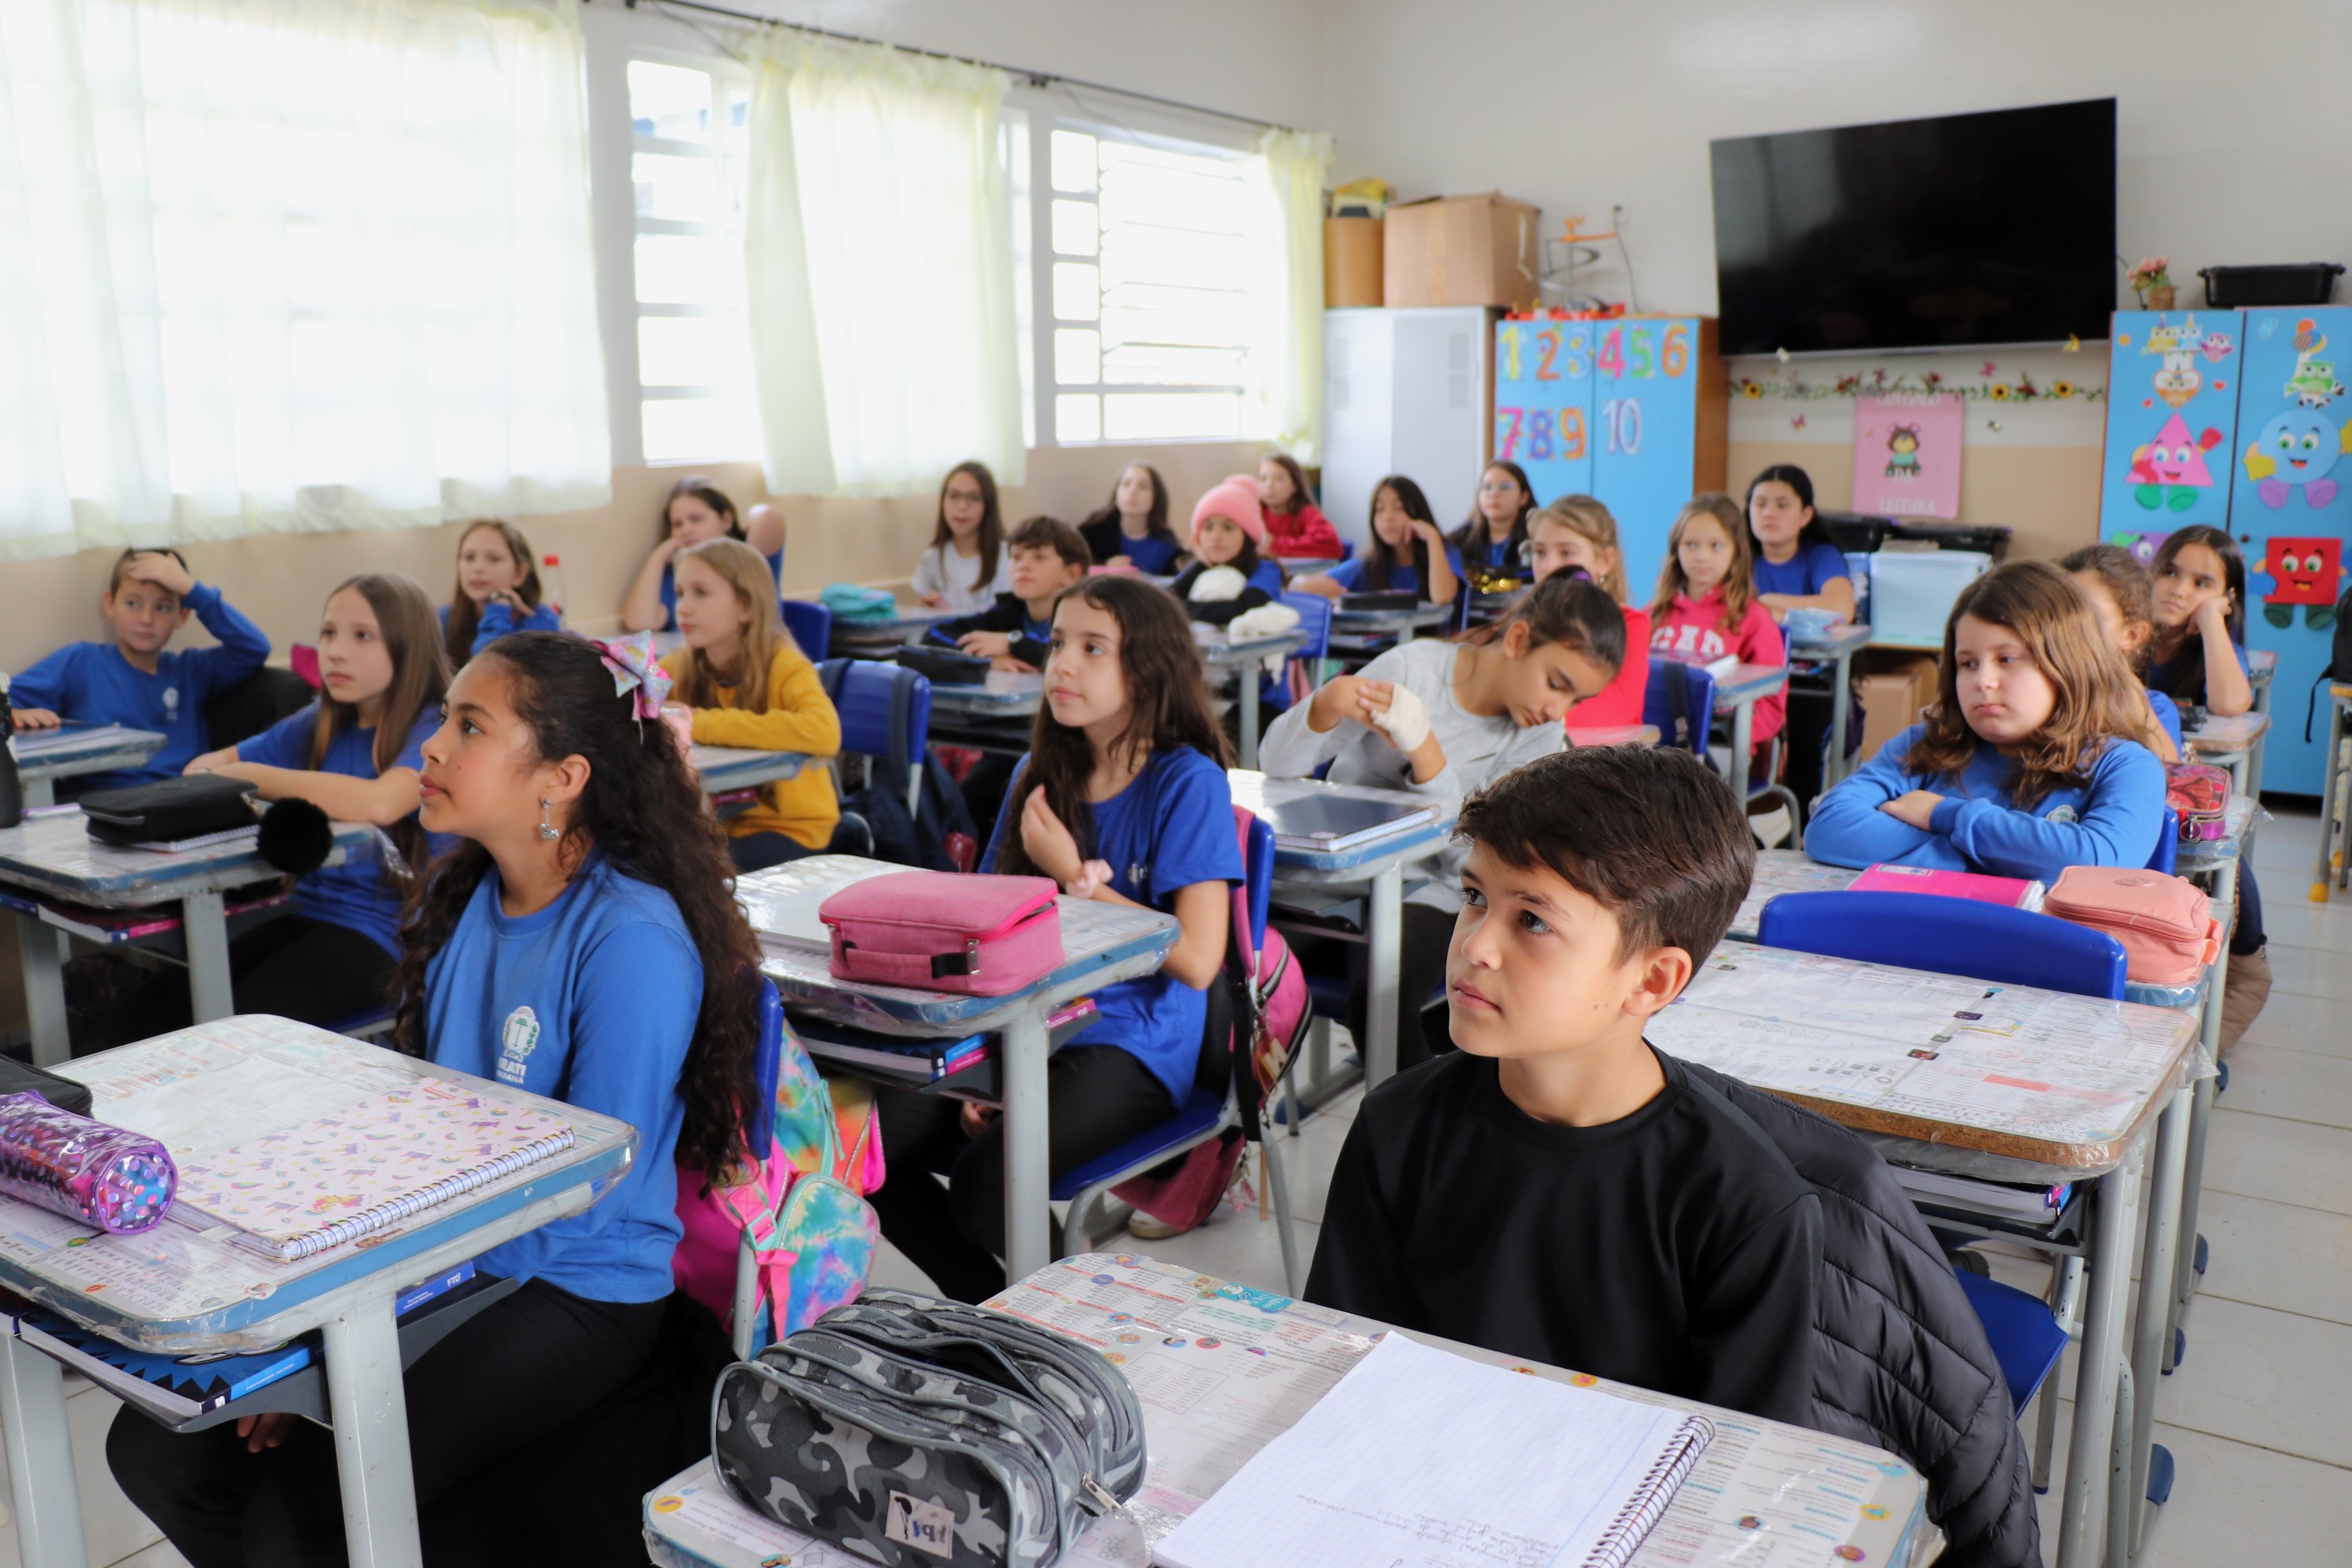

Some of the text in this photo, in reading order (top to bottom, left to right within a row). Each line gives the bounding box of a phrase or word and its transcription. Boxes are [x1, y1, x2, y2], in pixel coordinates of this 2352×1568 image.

[1500, 325, 1688, 380] 1 2 3 4 5 6
[1498, 399, 1642, 461] 7 8 9 10
[447, 1272, 462, 1287] FTD
